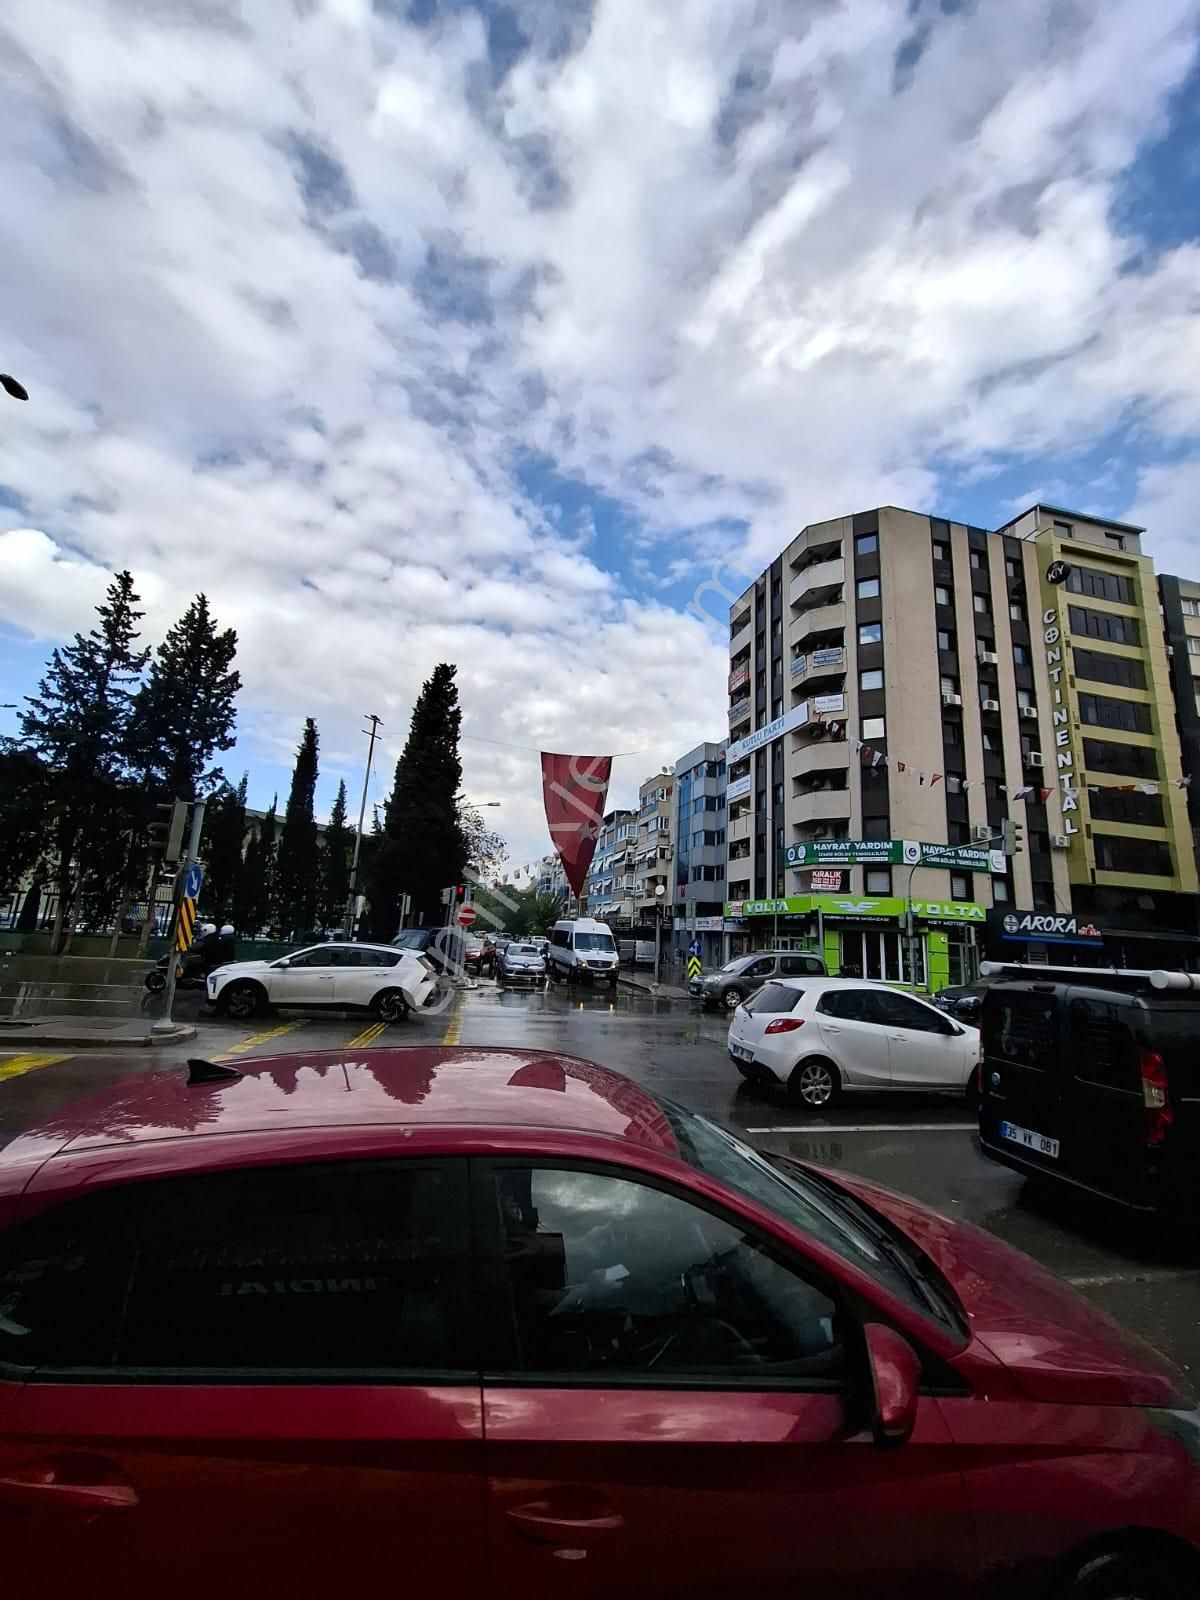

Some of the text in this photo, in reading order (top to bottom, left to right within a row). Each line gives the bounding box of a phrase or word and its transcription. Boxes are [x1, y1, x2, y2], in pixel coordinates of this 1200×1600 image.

[1042, 608, 1080, 835] CONTINENTAL
[813, 841, 893, 851] HAYRAT YARDIM
[746, 901, 789, 913] VOLTA
[911, 903, 984, 918] VOLTA
[1019, 915, 1077, 933] ARORA
[1007, 1126, 1057, 1156] 35 VK 081
